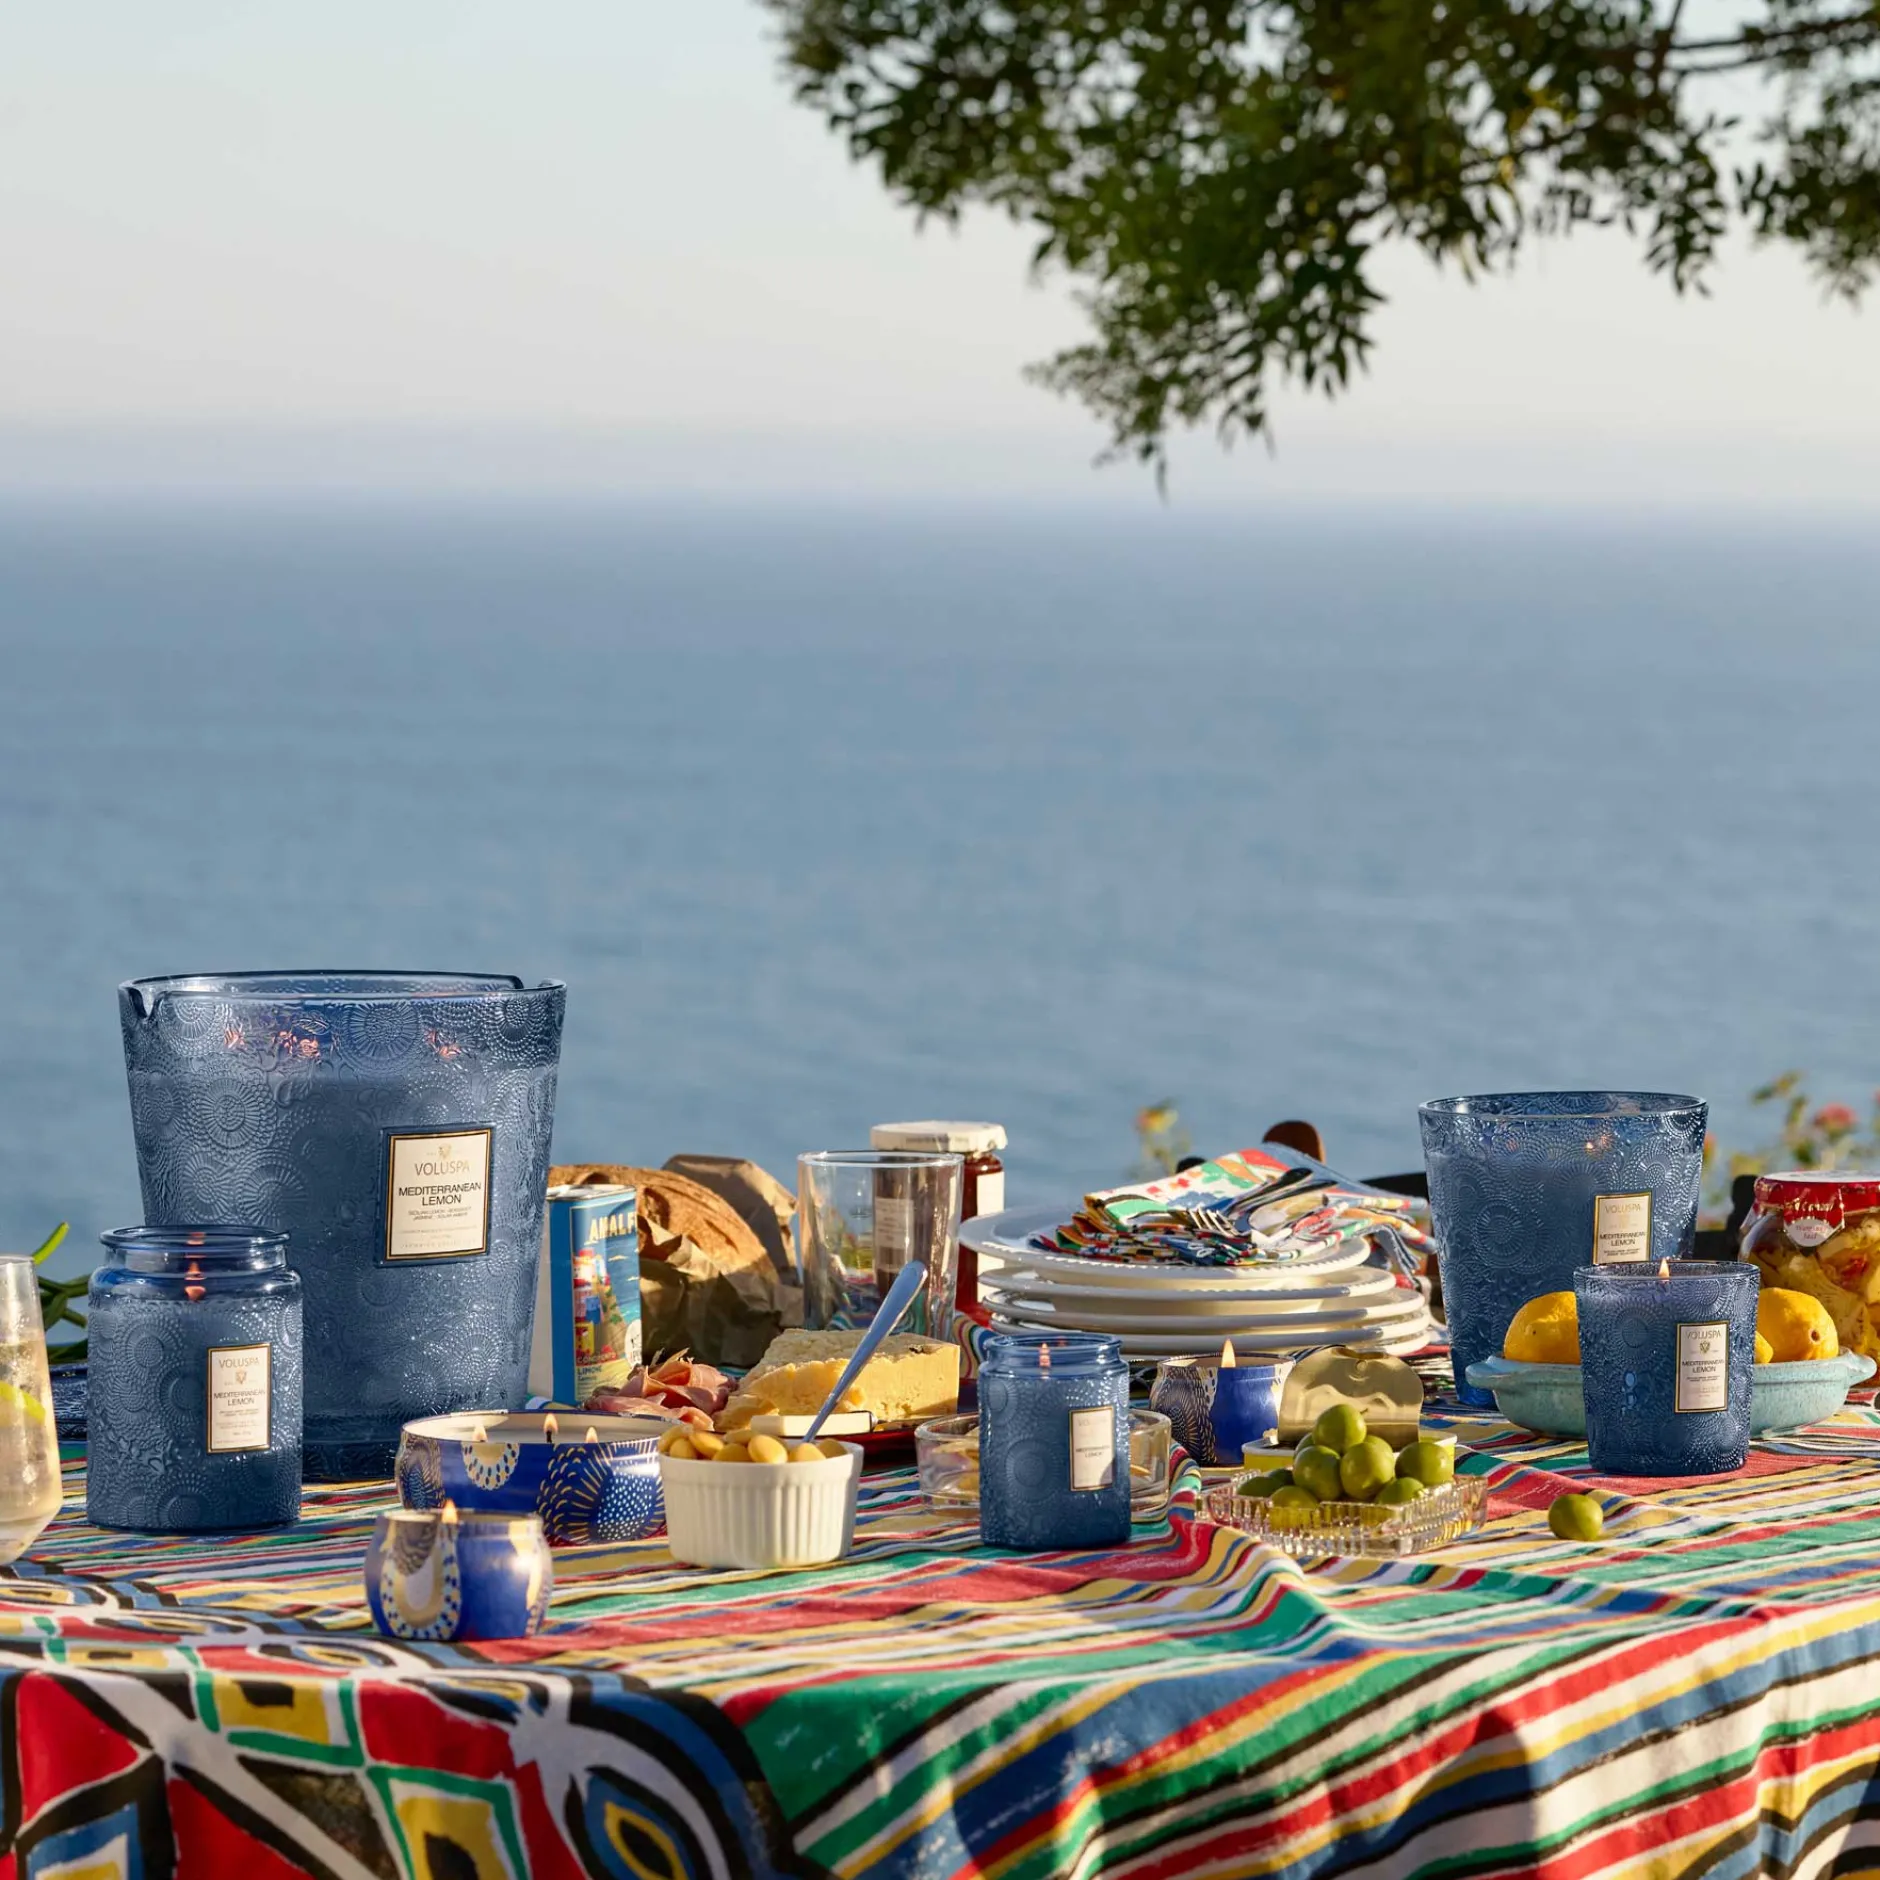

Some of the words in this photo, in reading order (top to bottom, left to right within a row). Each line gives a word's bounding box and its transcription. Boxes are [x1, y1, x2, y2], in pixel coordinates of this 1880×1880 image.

[414, 1160, 470, 1176] VOLUSPA
[398, 1182, 482, 1197] MEDITERRANEAN
[421, 1194, 462, 1206] LEMON
[1611, 1239, 1635, 1247] LEMON
[1687, 1328, 1721, 1340] VOLUSPA
[219, 1357, 259, 1369] VOLUSPA
[1692, 1365, 1716, 1374] LEMON
[214, 1388, 265, 1399] MEDITERRANEAN
[227, 1397, 254, 1406] LEMON
